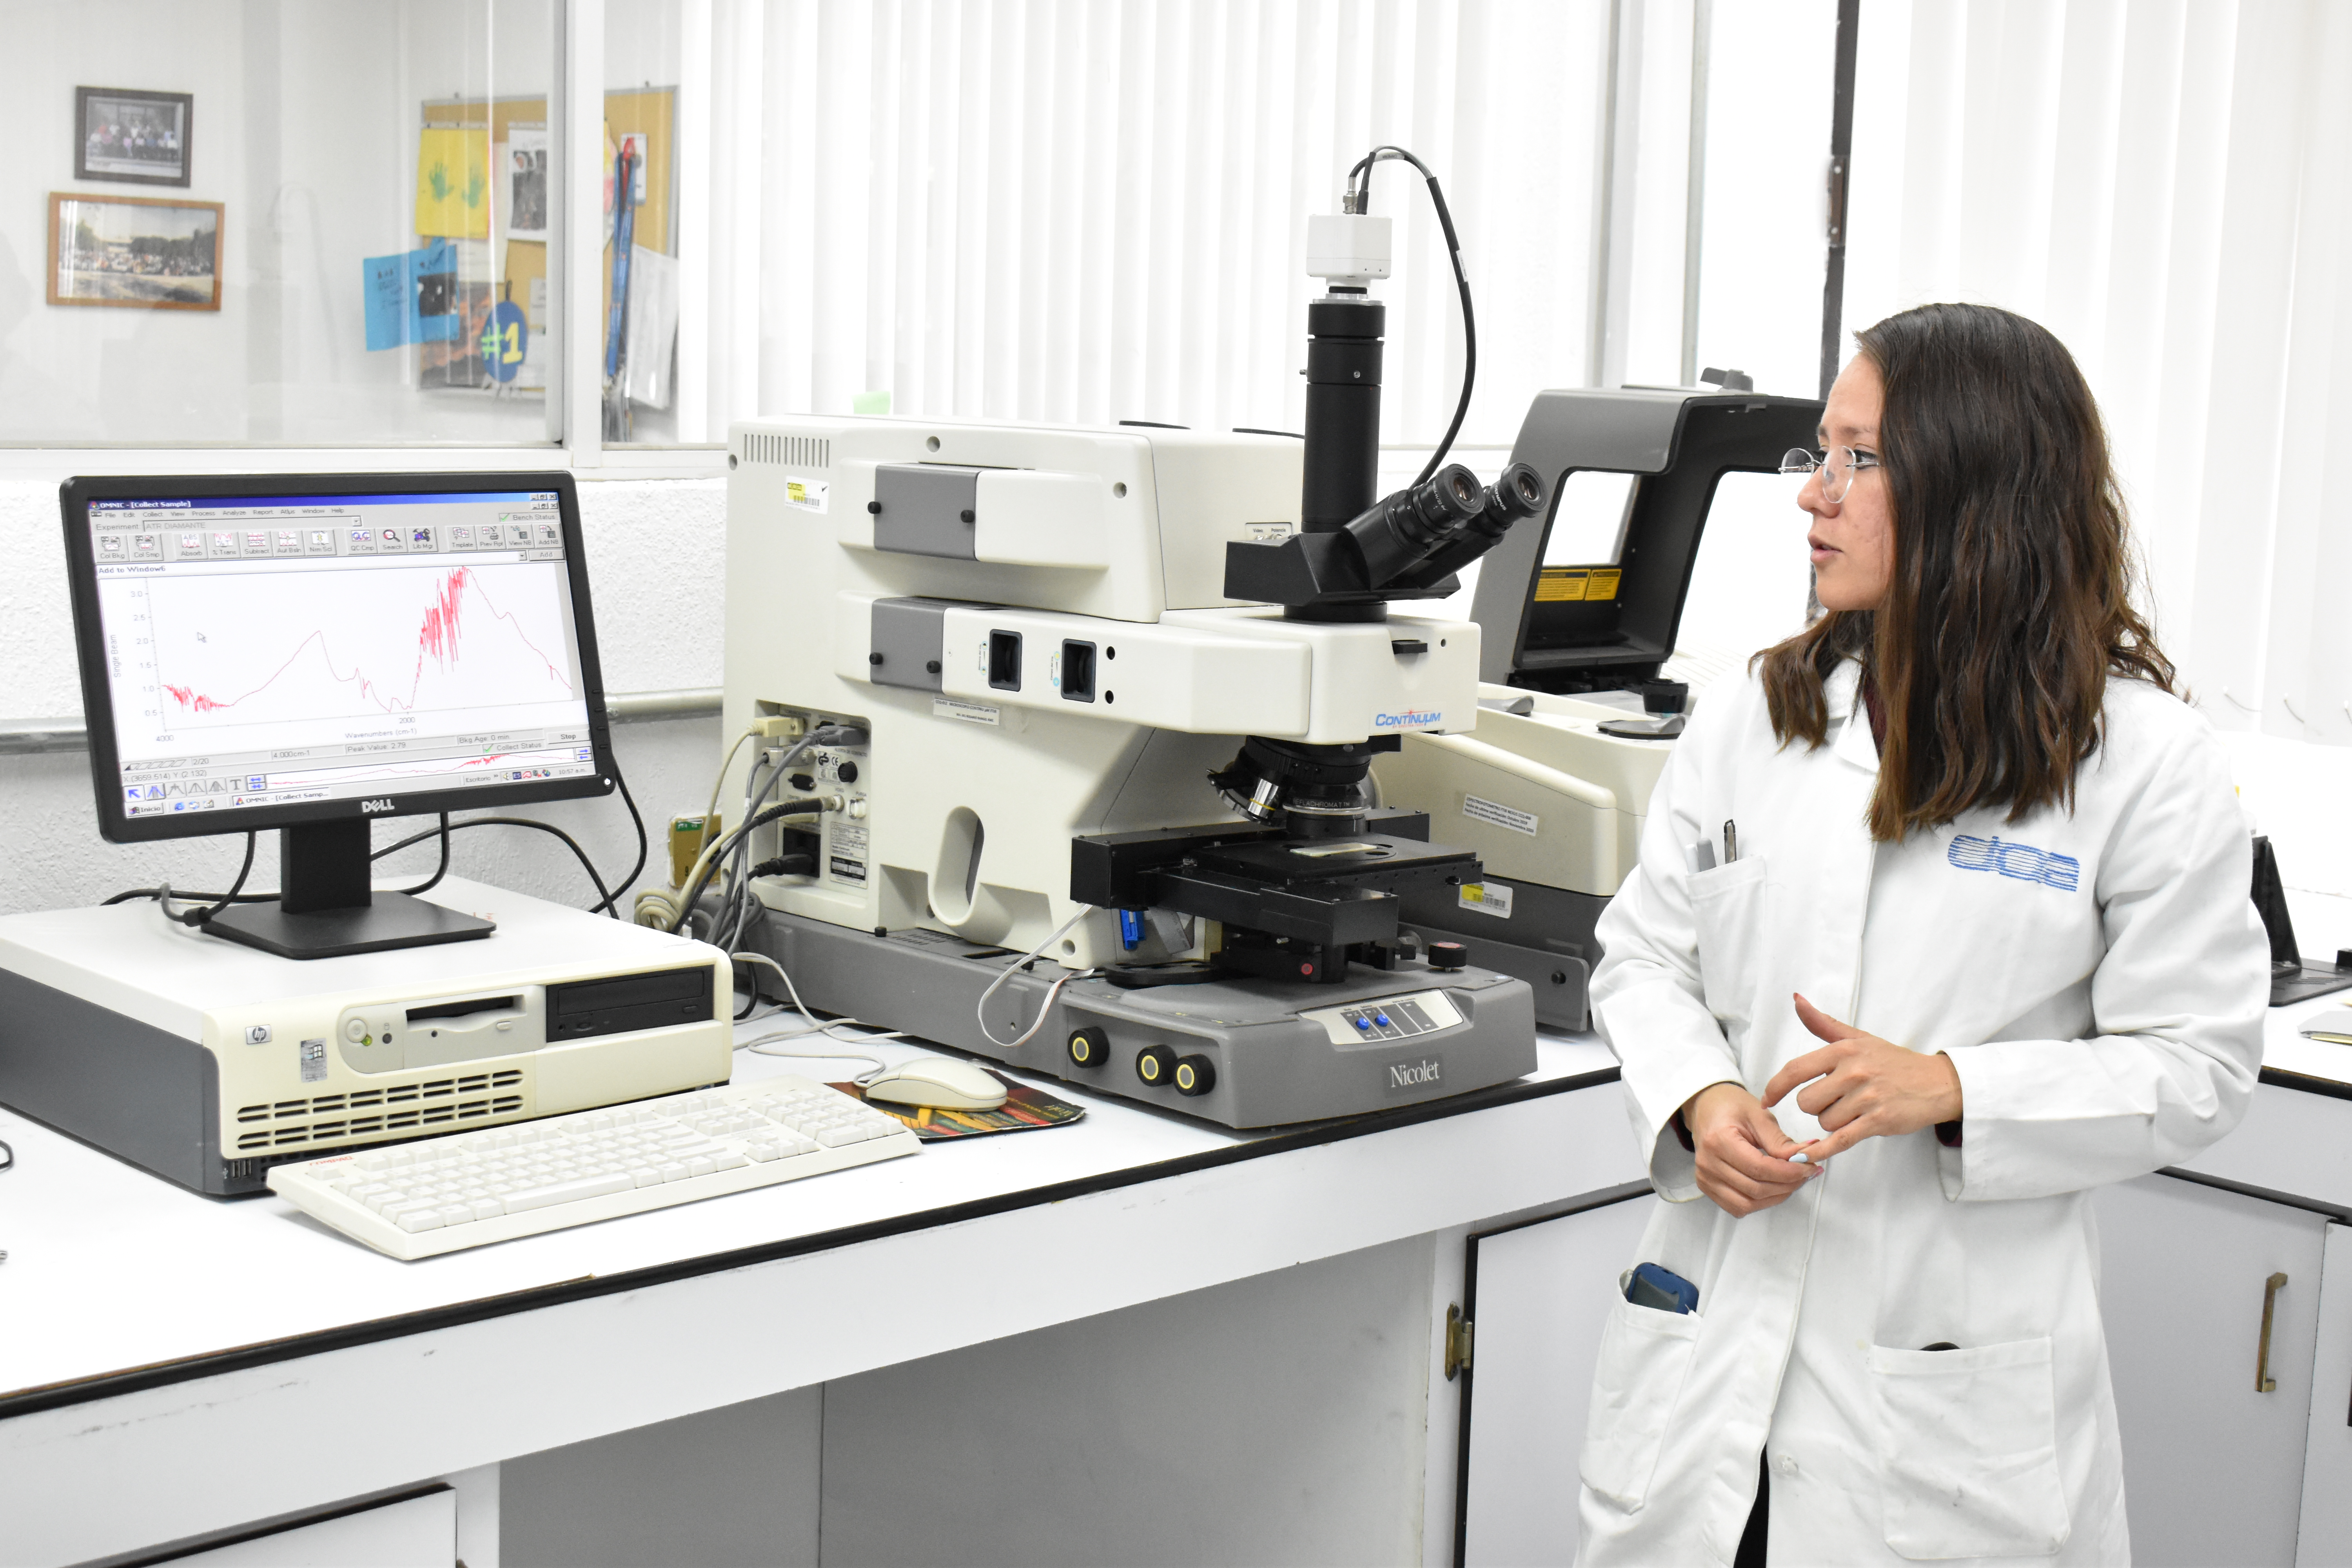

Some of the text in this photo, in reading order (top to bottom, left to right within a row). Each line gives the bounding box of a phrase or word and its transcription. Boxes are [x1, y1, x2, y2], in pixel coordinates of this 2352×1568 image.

[481, 322, 523, 364] #1
[1495, 485, 1507, 510] OLYMPUS
[110, 634, 122, 678] Single Beam
[345, 730, 393, 739] Wavenumbers
[361, 799, 395, 813] DELL
[1509, 822, 1526, 830] Noviembre
[254, 1026, 266, 1043] hp
[1390, 1060, 1440, 1087] Nicolet
